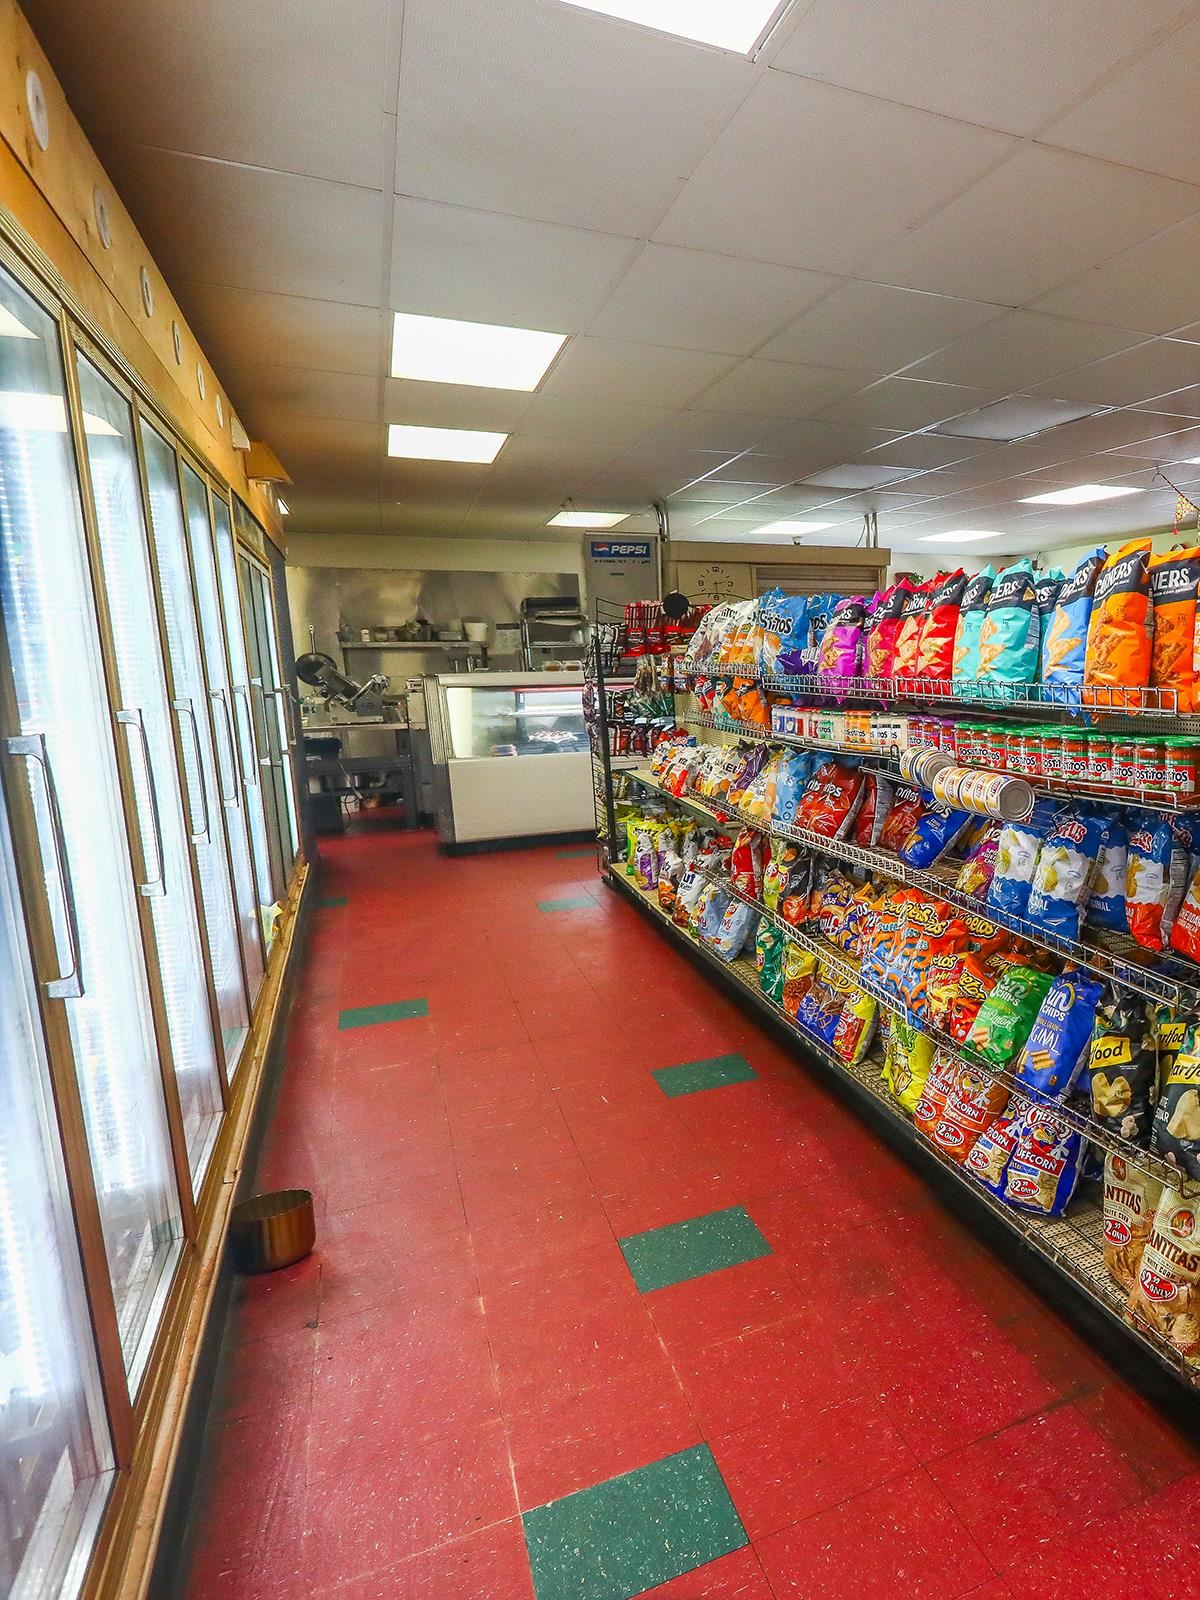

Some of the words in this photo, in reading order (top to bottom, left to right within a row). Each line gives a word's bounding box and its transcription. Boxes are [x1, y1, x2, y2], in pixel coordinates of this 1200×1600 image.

[611, 545, 647, 554] PEPSI
[1094, 560, 1135, 596] CORNERS
[1042, 1006, 1066, 1022] CHIPS
[1016, 1147, 1058, 1172] UFFCORN
[1147, 1229, 1200, 1273] ANTITAS
